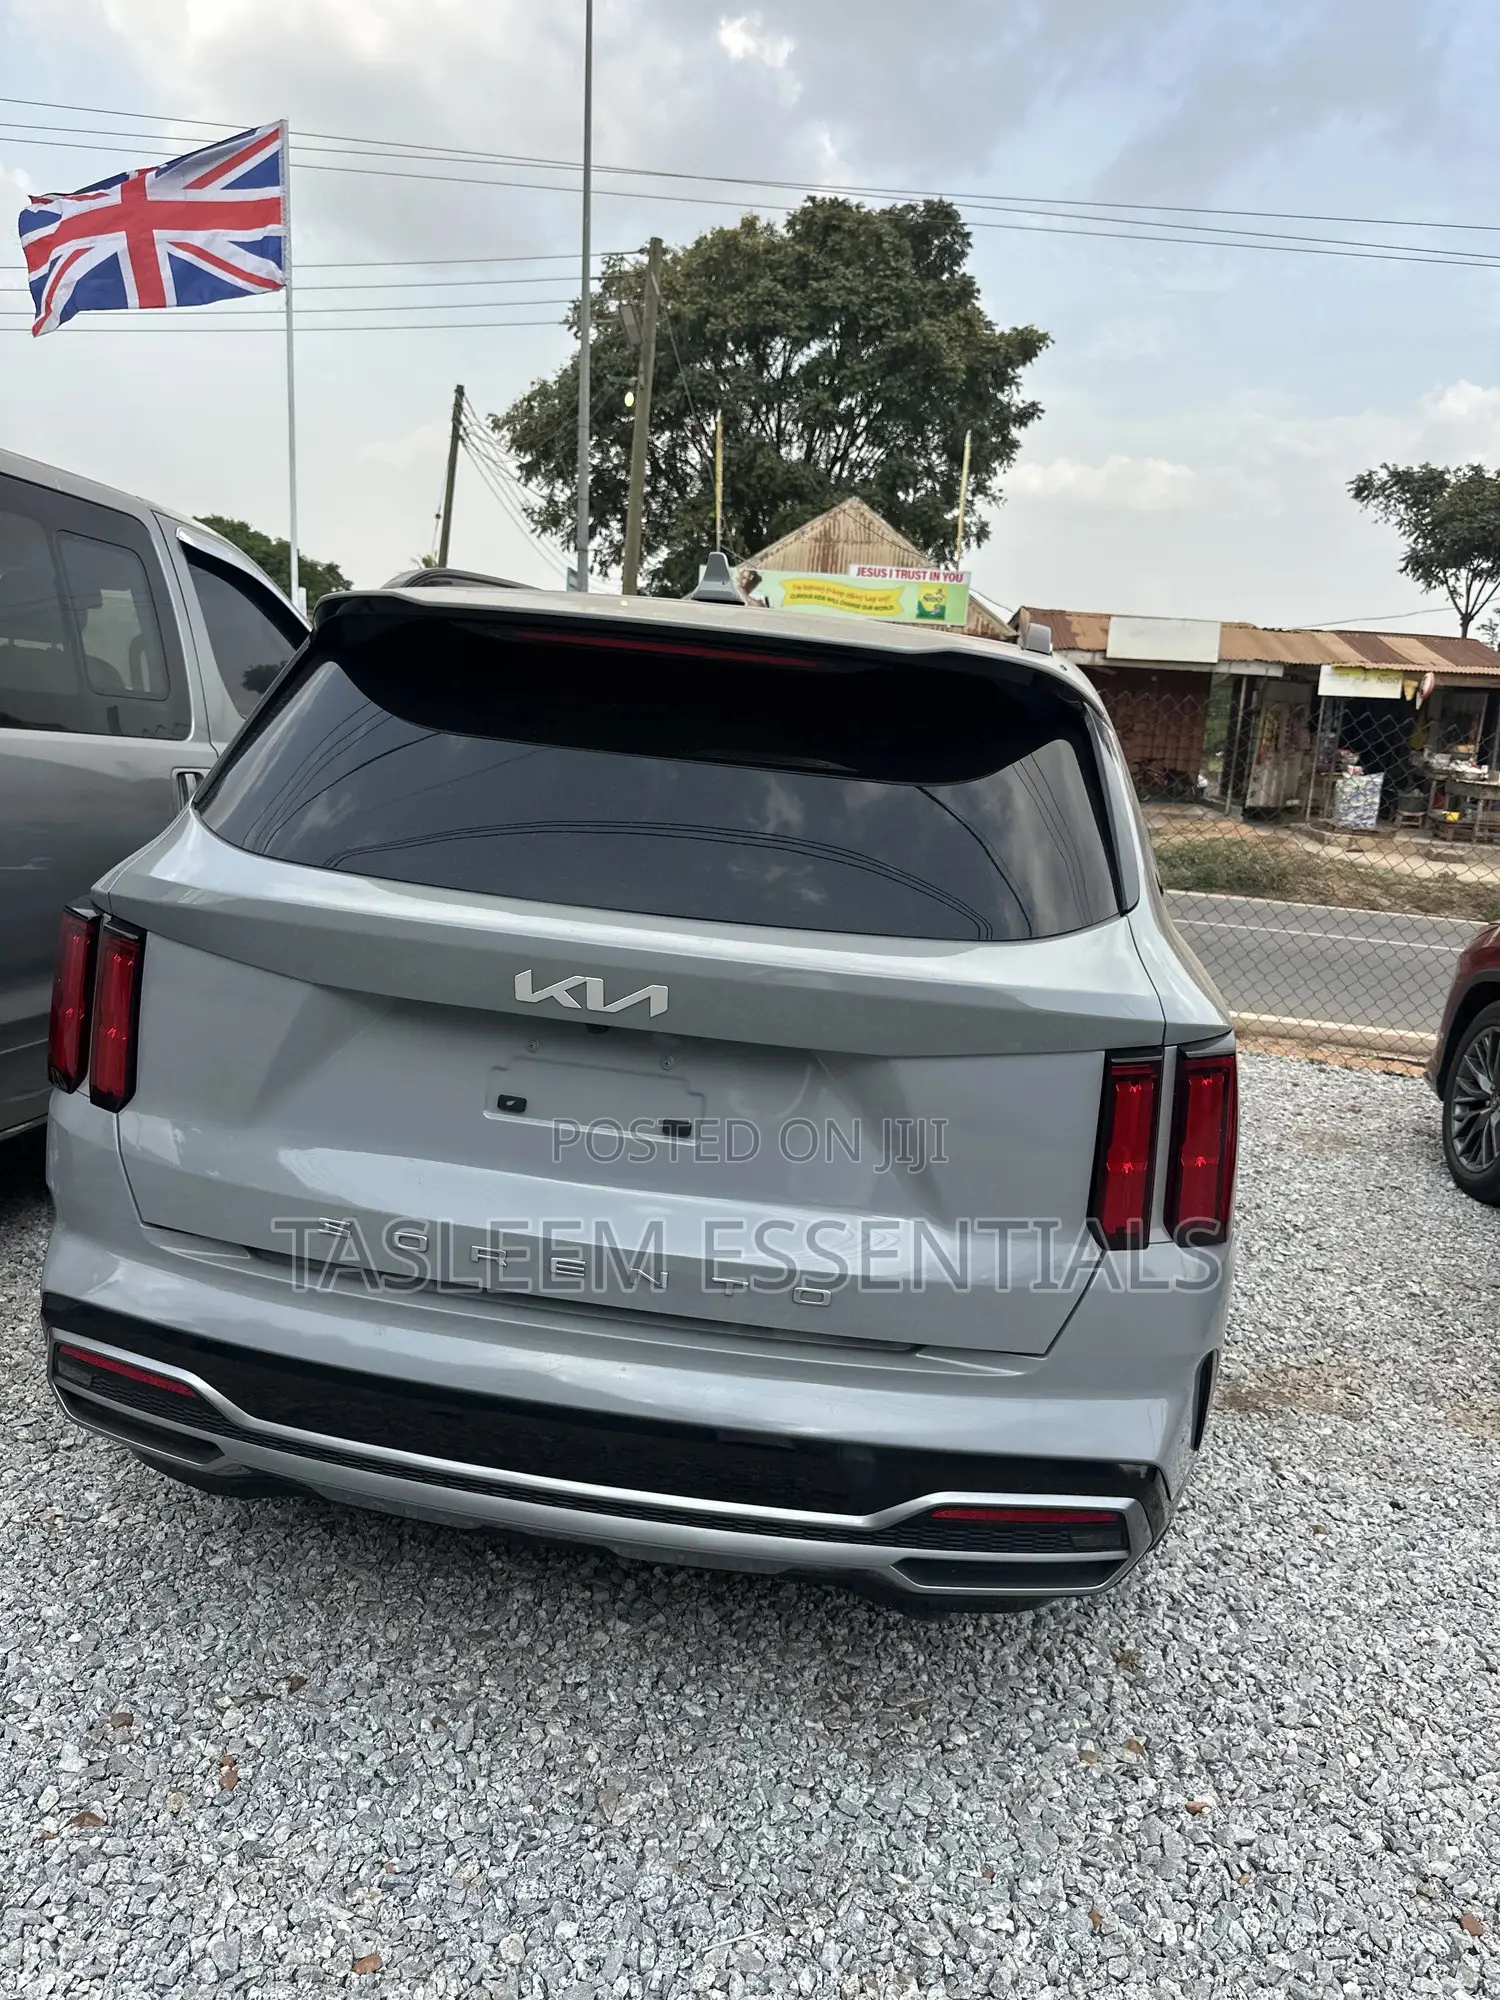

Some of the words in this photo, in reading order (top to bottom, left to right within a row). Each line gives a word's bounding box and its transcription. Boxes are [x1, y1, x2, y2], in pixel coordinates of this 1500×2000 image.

[857, 567, 887, 578] JESUS
[889, 568, 893, 578] I
[894, 569, 927, 580] TRUST
[929, 571, 941, 581] IN
[942, 572, 964, 583] YOU
[514, 969, 669, 1018] KIA
[317, 1216, 834, 1308] SORENTO
